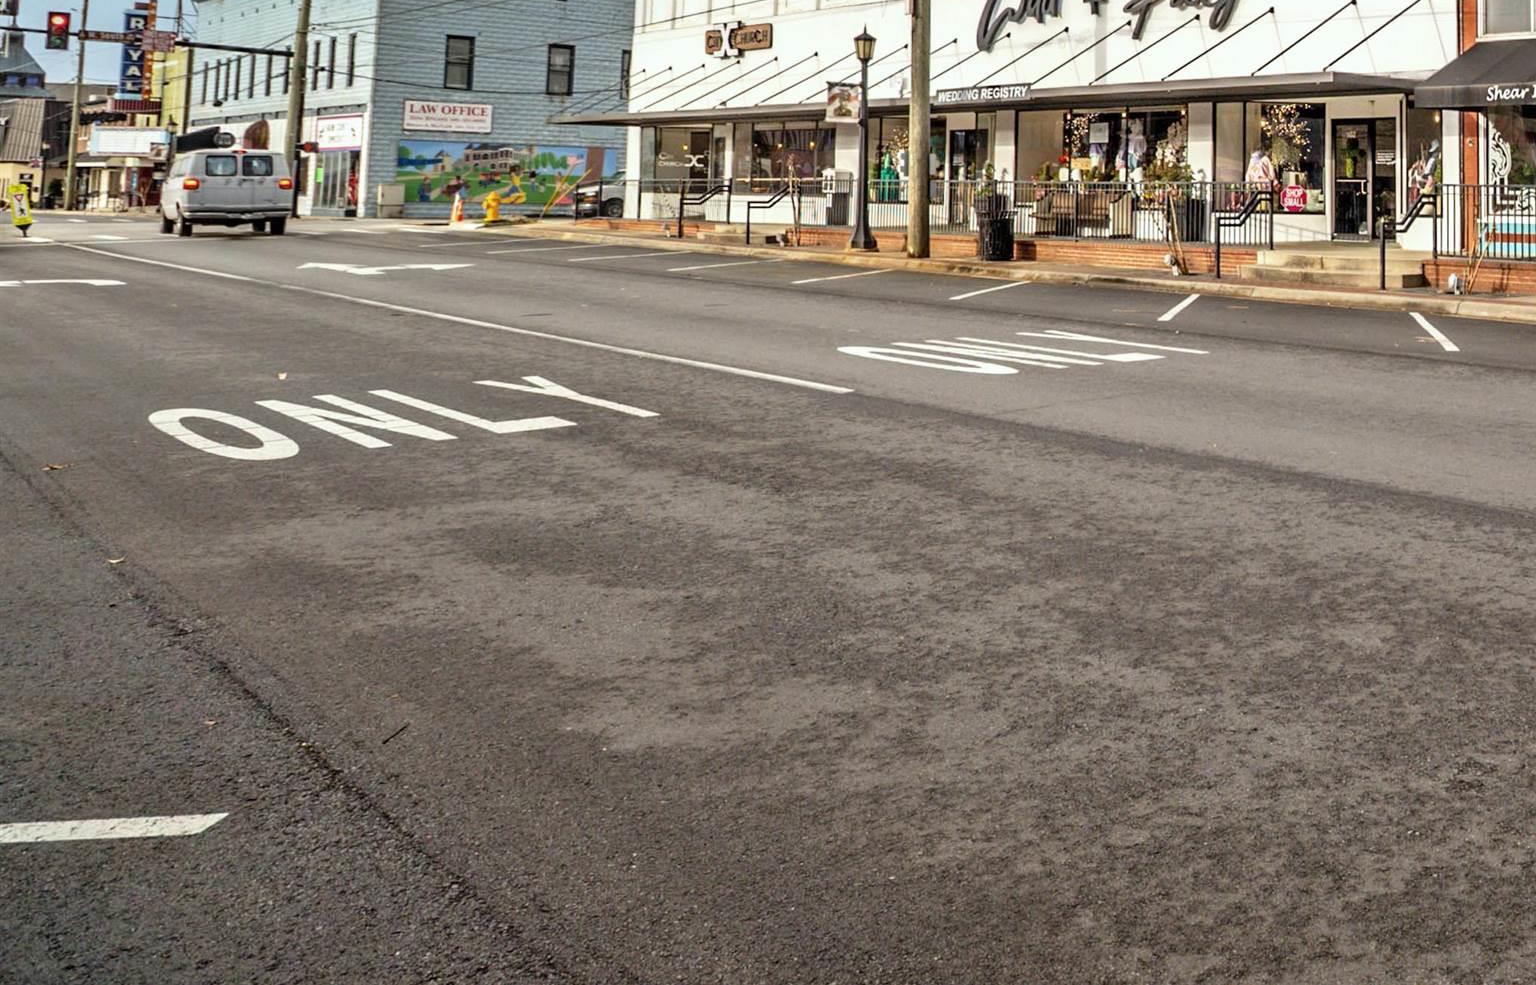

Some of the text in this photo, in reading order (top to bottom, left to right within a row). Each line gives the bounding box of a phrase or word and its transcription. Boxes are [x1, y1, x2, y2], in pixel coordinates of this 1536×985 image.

[938, 85, 1028, 103] WEDDING REGISTRY
[1487, 84, 1529, 102] Shear
[409, 104, 488, 116] LAW OFFICE
[1286, 188, 1303, 197] SHOP
[1284, 197, 1304, 207] SMALL
[837, 330, 1210, 375] ONLY
[148, 375, 661, 461] ONLY
